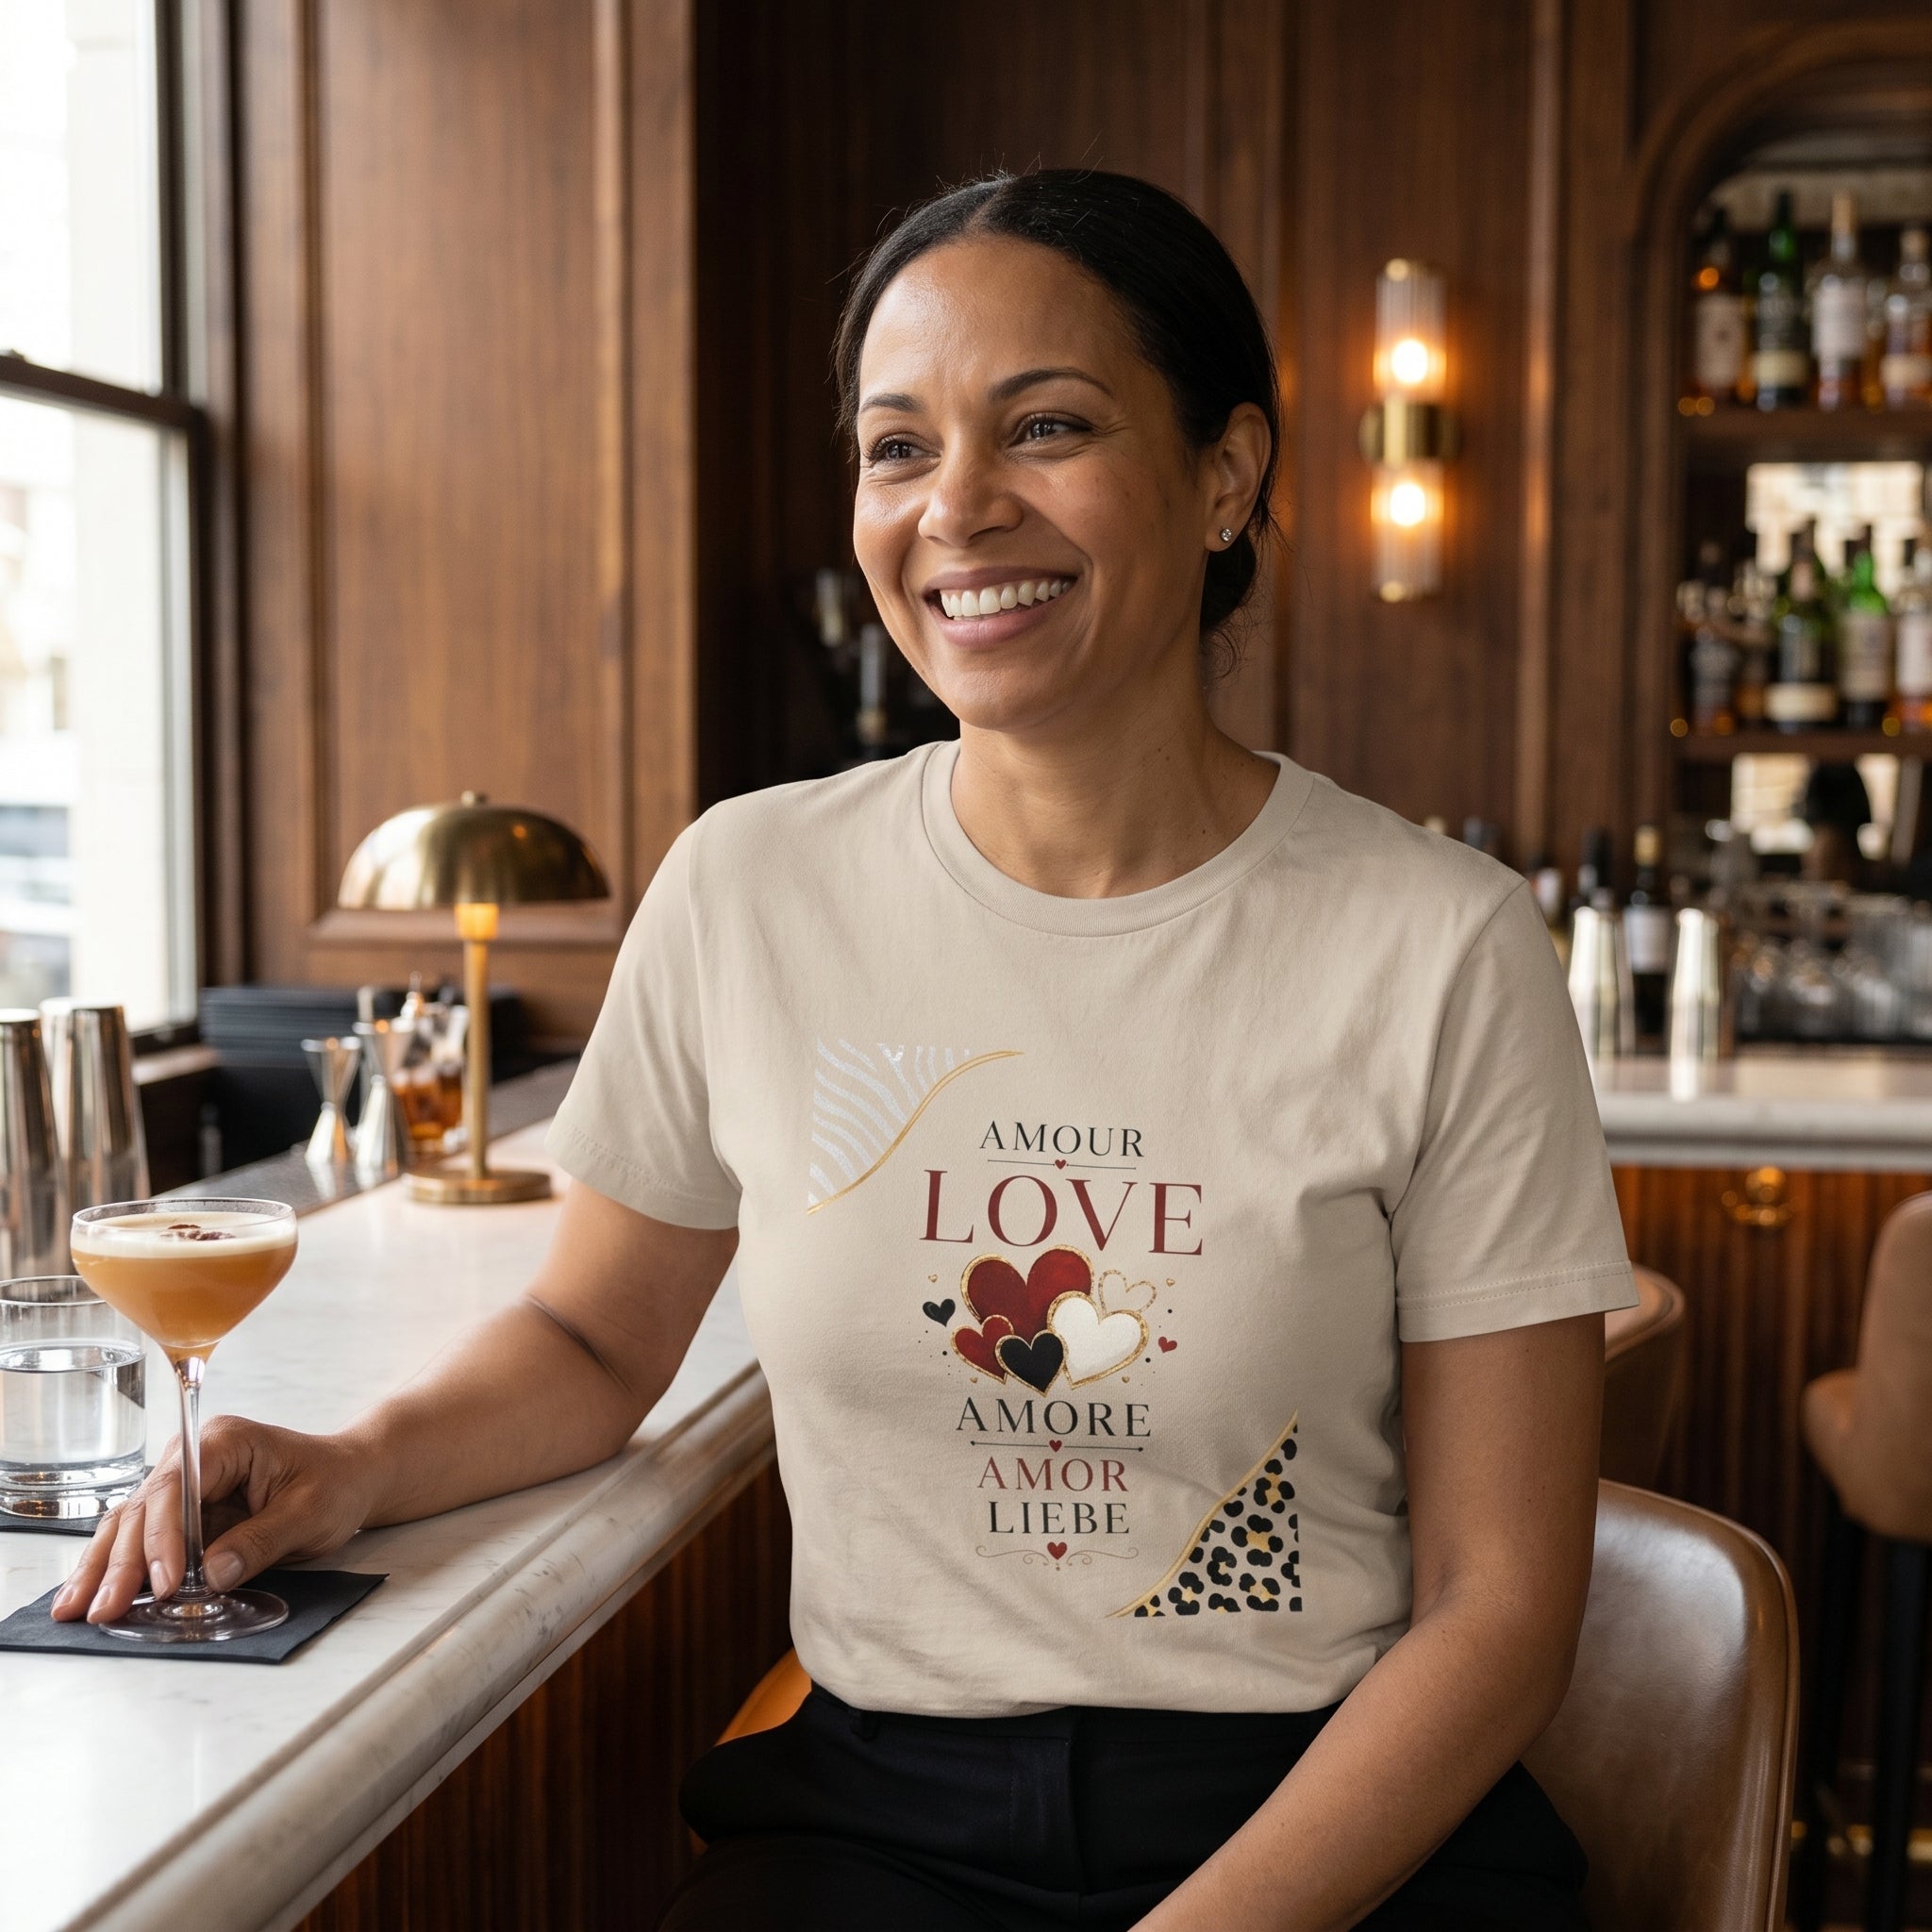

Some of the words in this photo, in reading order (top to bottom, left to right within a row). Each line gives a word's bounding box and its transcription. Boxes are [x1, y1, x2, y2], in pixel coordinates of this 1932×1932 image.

[979, 1120, 1145, 1158] AMOUR
[919, 1169, 1204, 1257] LOVE
[956, 1396, 1152, 1438] AMORE
[977, 1456, 1129, 1492] AMOR
[989, 1501, 1130, 1535] LIEBE
